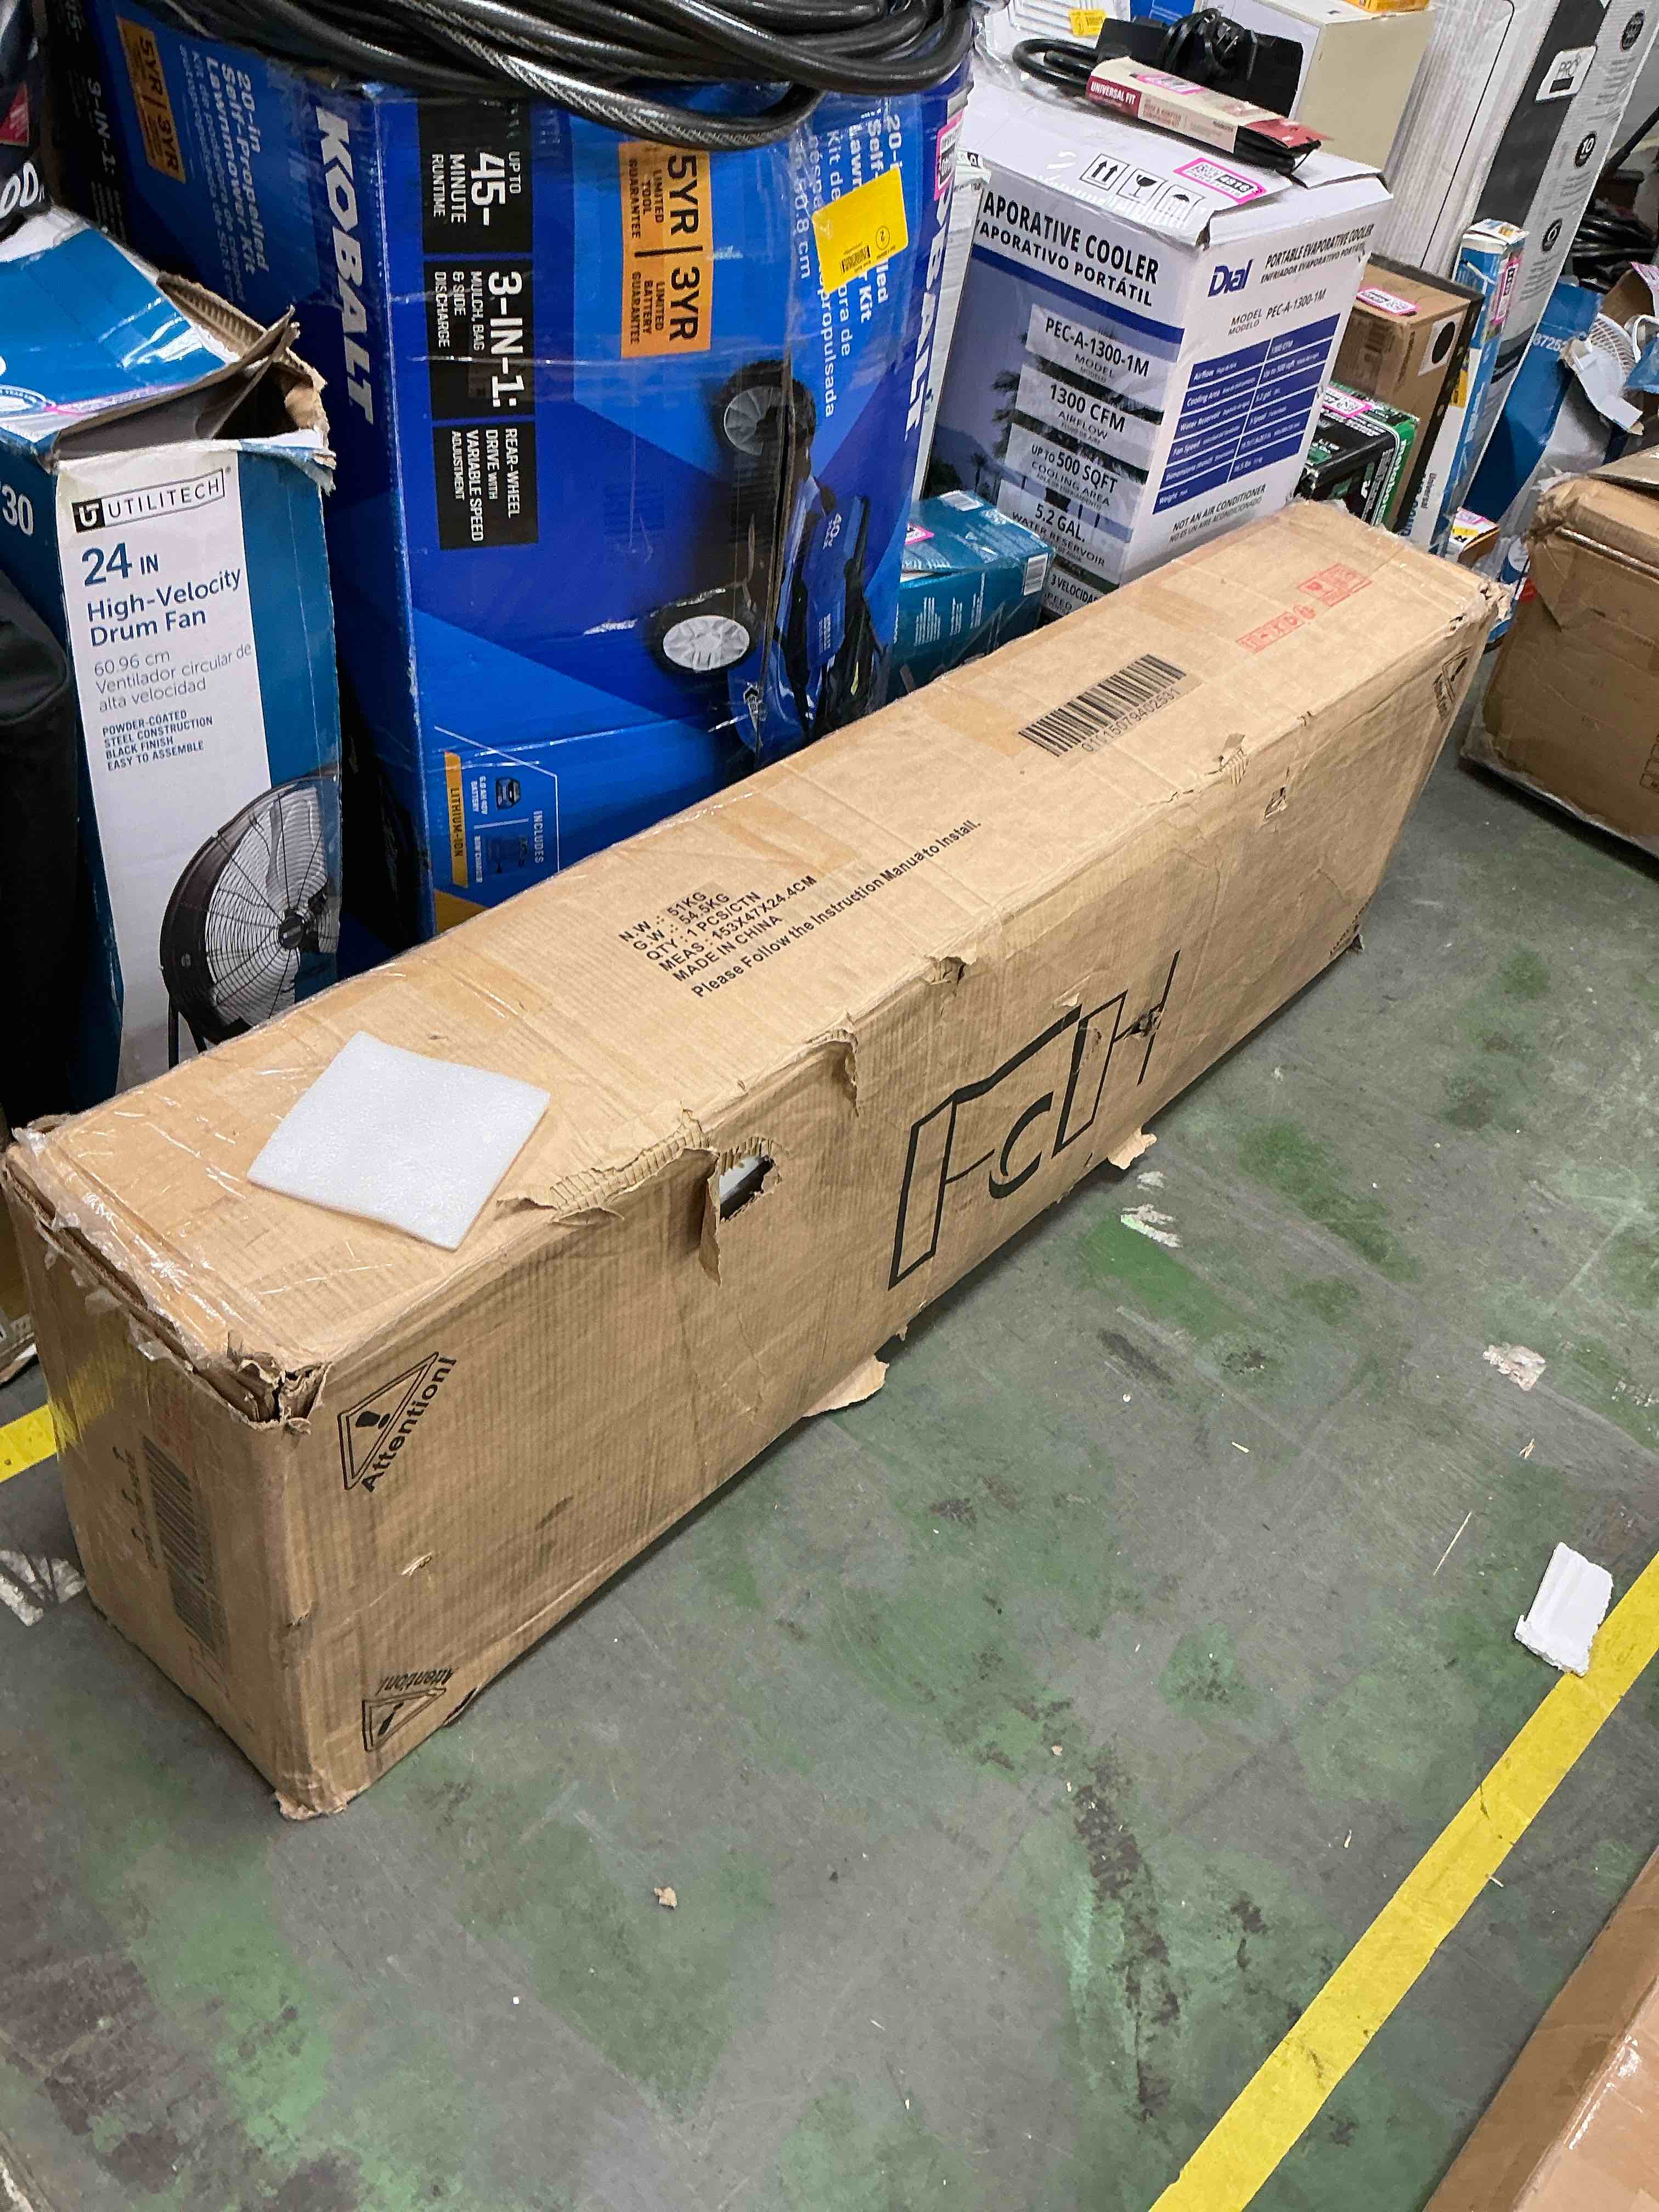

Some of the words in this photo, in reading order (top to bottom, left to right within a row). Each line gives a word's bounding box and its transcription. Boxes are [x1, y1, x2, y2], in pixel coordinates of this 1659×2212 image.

[236, 70, 261, 153] 20-in
[1090, 81, 1125, 101] UNIVERSAL
[1125, 93, 1137, 105] FIT
[206, 57, 247, 232] Lawnmower
[240, 234, 256, 275] Kit
[508, 151, 521, 172] UP
[827, 129, 842, 166] Kit
[886, 114, 903, 170] 20-i
[222, 63, 269, 273] Self-propelled
[432, 154, 445, 217] RUNTIME
[449, 154, 467, 224] MINUTE
[471, 152, 506, 226] 45-
[509, 176, 522, 194] TO
[809, 136, 824, 208] céspe
[830, 171, 844, 201] de
[629, 159, 641, 239] GUARANTEE
[642, 179, 652, 216] TOOL
[653, 170, 664, 223] LIMITED
[667, 154, 699, 236] 5YR
[798, 240, 811, 279] cm
[983, 191, 1081, 252] APORATIVE
[1085, 234, 1159, 285] COOLER
[1265, 246, 1304, 268] PORTABLE
[1303, 232, 1349, 257] EVAPORATIVE
[1348, 223, 1375, 243] COOLER
[315, 107, 374, 425] KOBALT
[978, 221, 1069, 270] APORATIVO
[1074, 262, 1152, 307] PORTÁTIL
[1207, 258, 1255, 297] Dial
[1260, 264, 1296, 284] ENFRIADOR
[435, 271, 450, 348] DISCHARGE
[453, 284, 466, 317] SIDE
[471, 271, 484, 322] MULCH,
[631, 272, 641, 345] GUARANTEE
[642, 280, 653, 334] BATTERY
[656, 281, 665, 331] LIMITED
[669, 266, 701, 341] 3YR
[859, 285, 873, 324] Kit
[1231, 308, 1262, 325] MODEL
[1266, 288, 1327, 320] PEC-A-1300-1M
[472, 324, 485, 351] BAG
[488, 271, 524, 408] 3-IN-1:
[840, 329, 853, 357] de
[1045, 317, 1150, 377] PEC-A-1300-1M
[1228, 320, 1260, 336] MODELO
[1075, 354, 1115, 379] MODEL
[1193, 369, 1215, 381] Airflow
[1050, 384, 1086, 413] 1300
[1090, 403, 1126, 432] CFM
[1058, 411, 1108, 439] AIRFLOW
[452, 430, 465, 500] ADJUSTMENT
[466, 429, 482, 496] VARIABLE
[486, 429, 500, 471] DRIVE
[505, 428, 520, 518] REAR-WHEEL
[1031, 443, 1043, 455] UP
[1045, 449, 1055, 462] TO
[1056, 451, 1080, 476] 500
[1081, 465, 1118, 494] SQFT
[108, 478, 219, 518] UTILITECH
[487, 472, 499, 500] WITH
[1031, 461, 1079, 491] COOLING
[1082, 487, 1110, 506] AREA
[1172, 517, 1190, 532] NOT
[1191, 511, 1201, 524] AN
[1202, 506, 1215, 518] AIR
[1216, 483, 1266, 512] CONDITIONER
[2, 484, 33, 536] 30
[469, 498, 484, 541] SPEED
[1035, 503, 1055, 526] 5.2
[1057, 516, 1085, 543] GAL.
[1012, 511, 1047, 536] WATER
[1049, 531, 1105, 567] RESERVOIR
[1169, 532, 1181, 543] NO
[82, 542, 133, 588] 24
[140, 553, 159, 576] IN
[1051, 574, 1056, 585] 3
[87, 567, 242, 623] High-Velocity
[91, 620, 159, 647] Drum
[166, 607, 207, 632] Fan
[94, 653, 140, 677] 60.96
[145, 650, 171, 666] cm
[95, 667, 176, 695] Ventilador
[181, 652, 233, 676] circular
[236, 643, 252, 659] de
[99, 697, 127, 713] alta
[131, 676, 207, 705] velocidad
[102, 709, 187, 737] POWDER-COATED
[104, 735, 133, 749] STEEL
[137, 715, 213, 741] CONSTRUCTION
[106, 743, 138, 760] BLACK
[140, 736, 174, 752] FINISH
[108, 756, 133, 772] EASY
[137, 753, 149, 764] TO
[152, 740, 205, 760] ASSEMBLE
[449, 787, 464, 857] LITHIUM-ION
[533, 810, 544, 864] INCLUDES
[646, 938, 679, 961] QTY
[687, 928, 698, 938] 1
[696, 891, 761, 932] PCS/CTN
[667, 891, 707, 917] 51KG
[679, 893, 730, 926] 54.5KG
[691, 964, 744, 998] Please
[741, 935, 791, 968] Follow
[788, 920, 815, 939] the
[810, 878, 885, 925] Instruction
[922, 844, 940, 859] to
[935, 819, 981, 848] Install.
[712, 875, 817, 940] 153X47X24.4CM
[672, 951, 720, 982] MADE
[717, 941, 736, 956] IN
[735, 915, 783, 945] CHINA
[360, 1356, 457, 1493] Attention!
